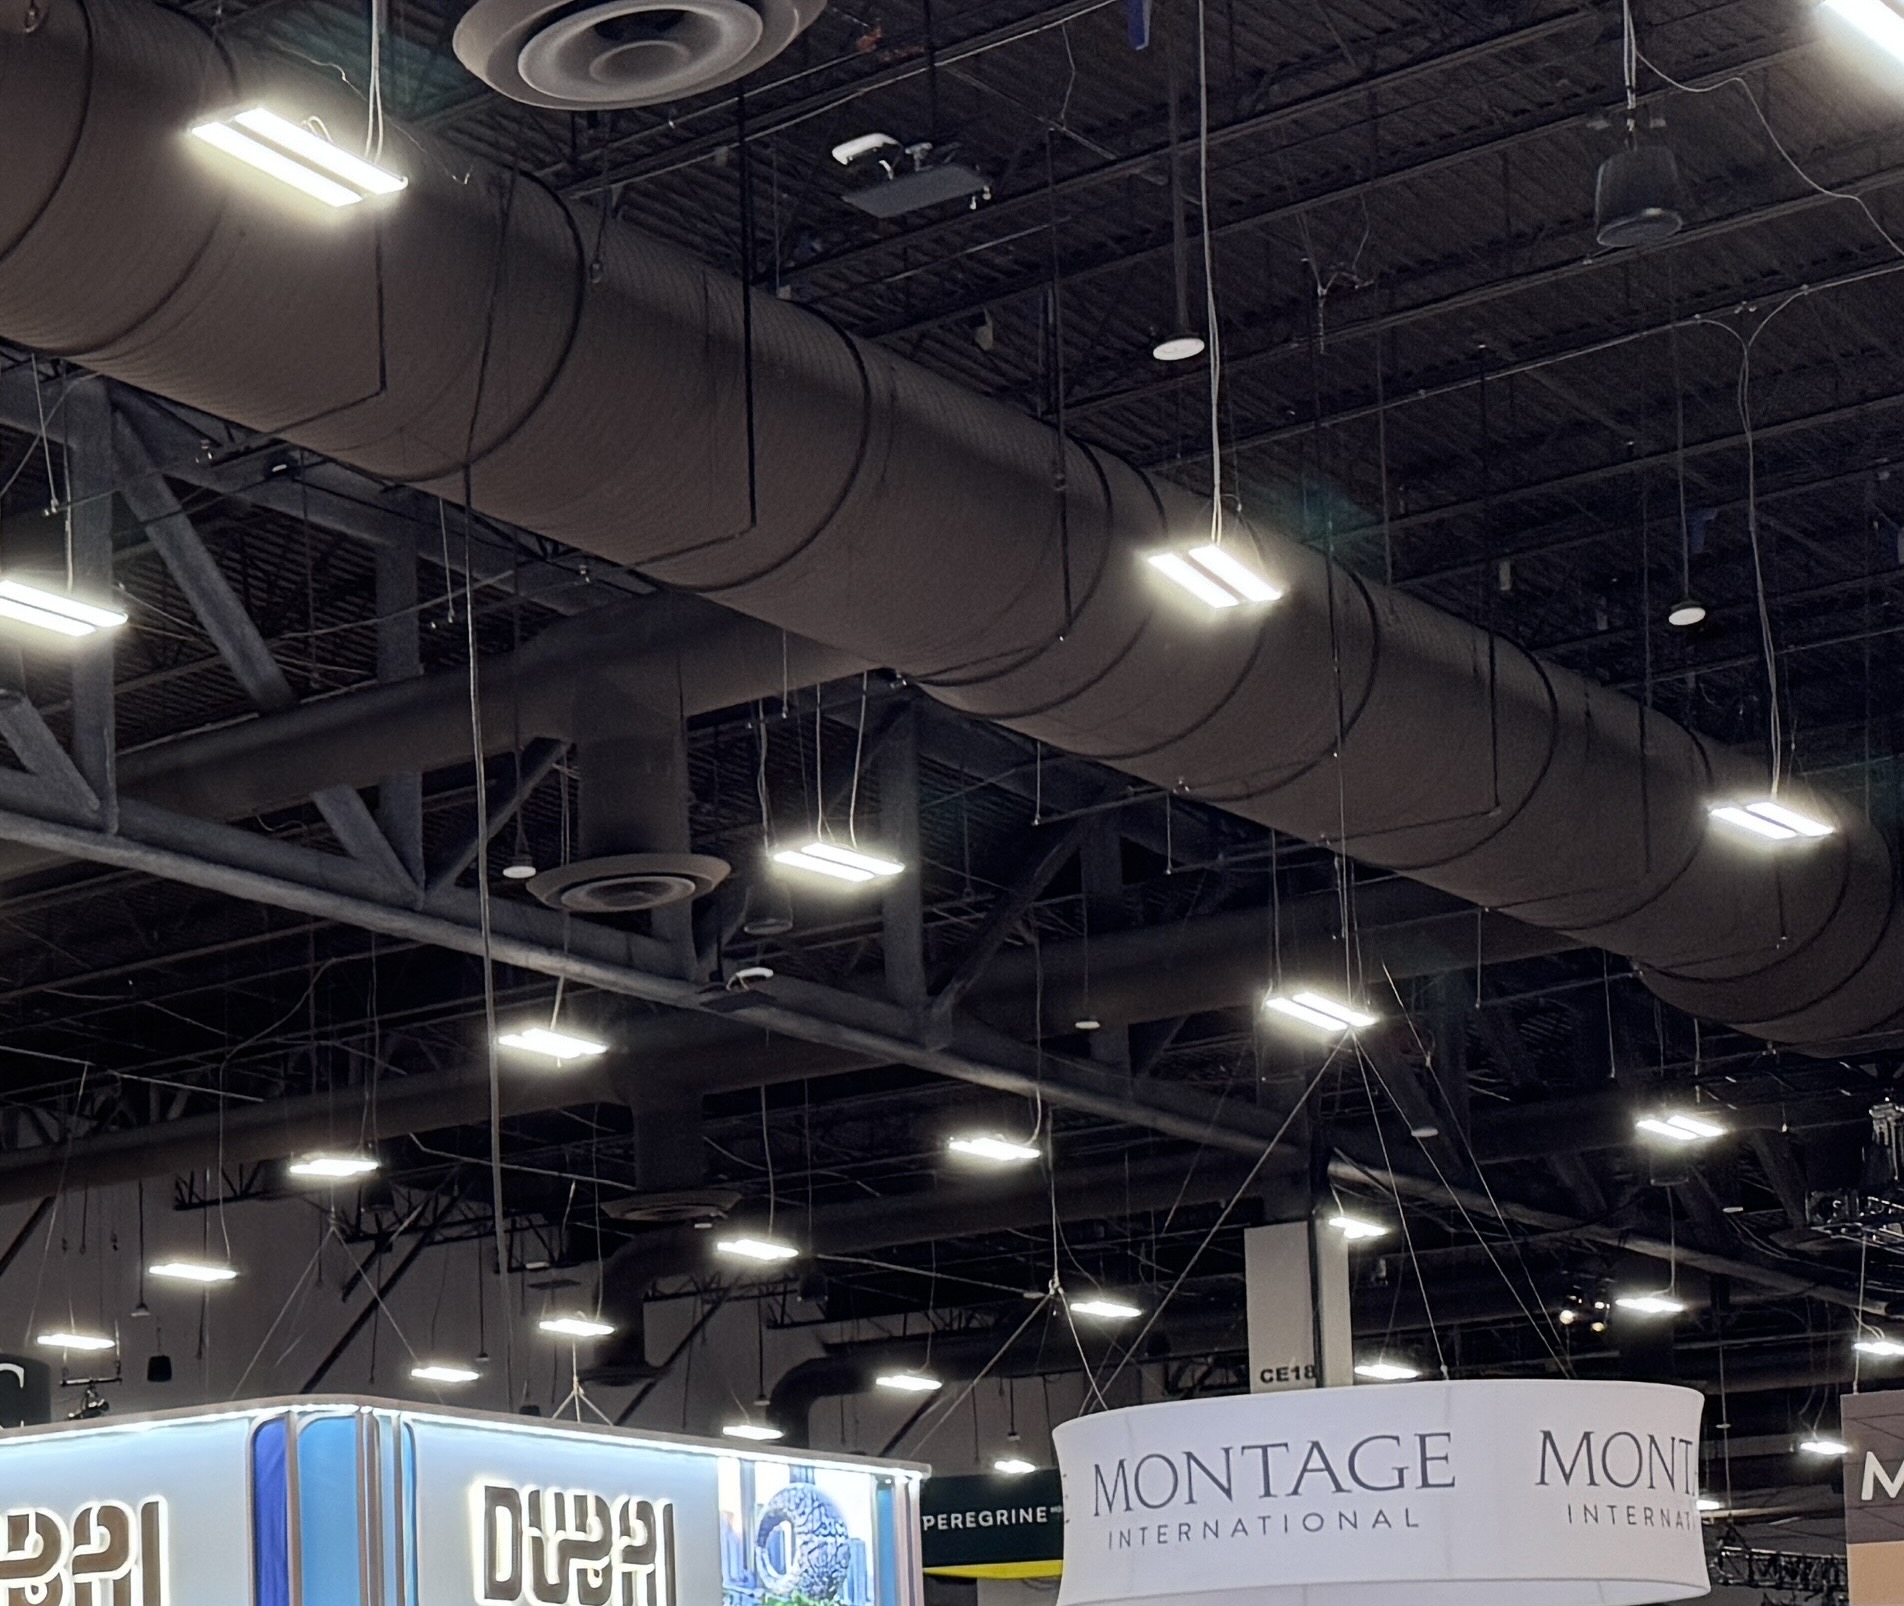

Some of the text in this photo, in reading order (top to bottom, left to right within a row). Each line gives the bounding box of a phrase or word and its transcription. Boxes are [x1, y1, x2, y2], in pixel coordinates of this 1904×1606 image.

[1260, 1363, 1316, 1385] CE18
[1093, 1430, 1699, 1518] MONTAGE MONT
[923, 1505, 1048, 1532] PEREGRINE
[1108, 1506, 1420, 1552] INTERNATIONAL
